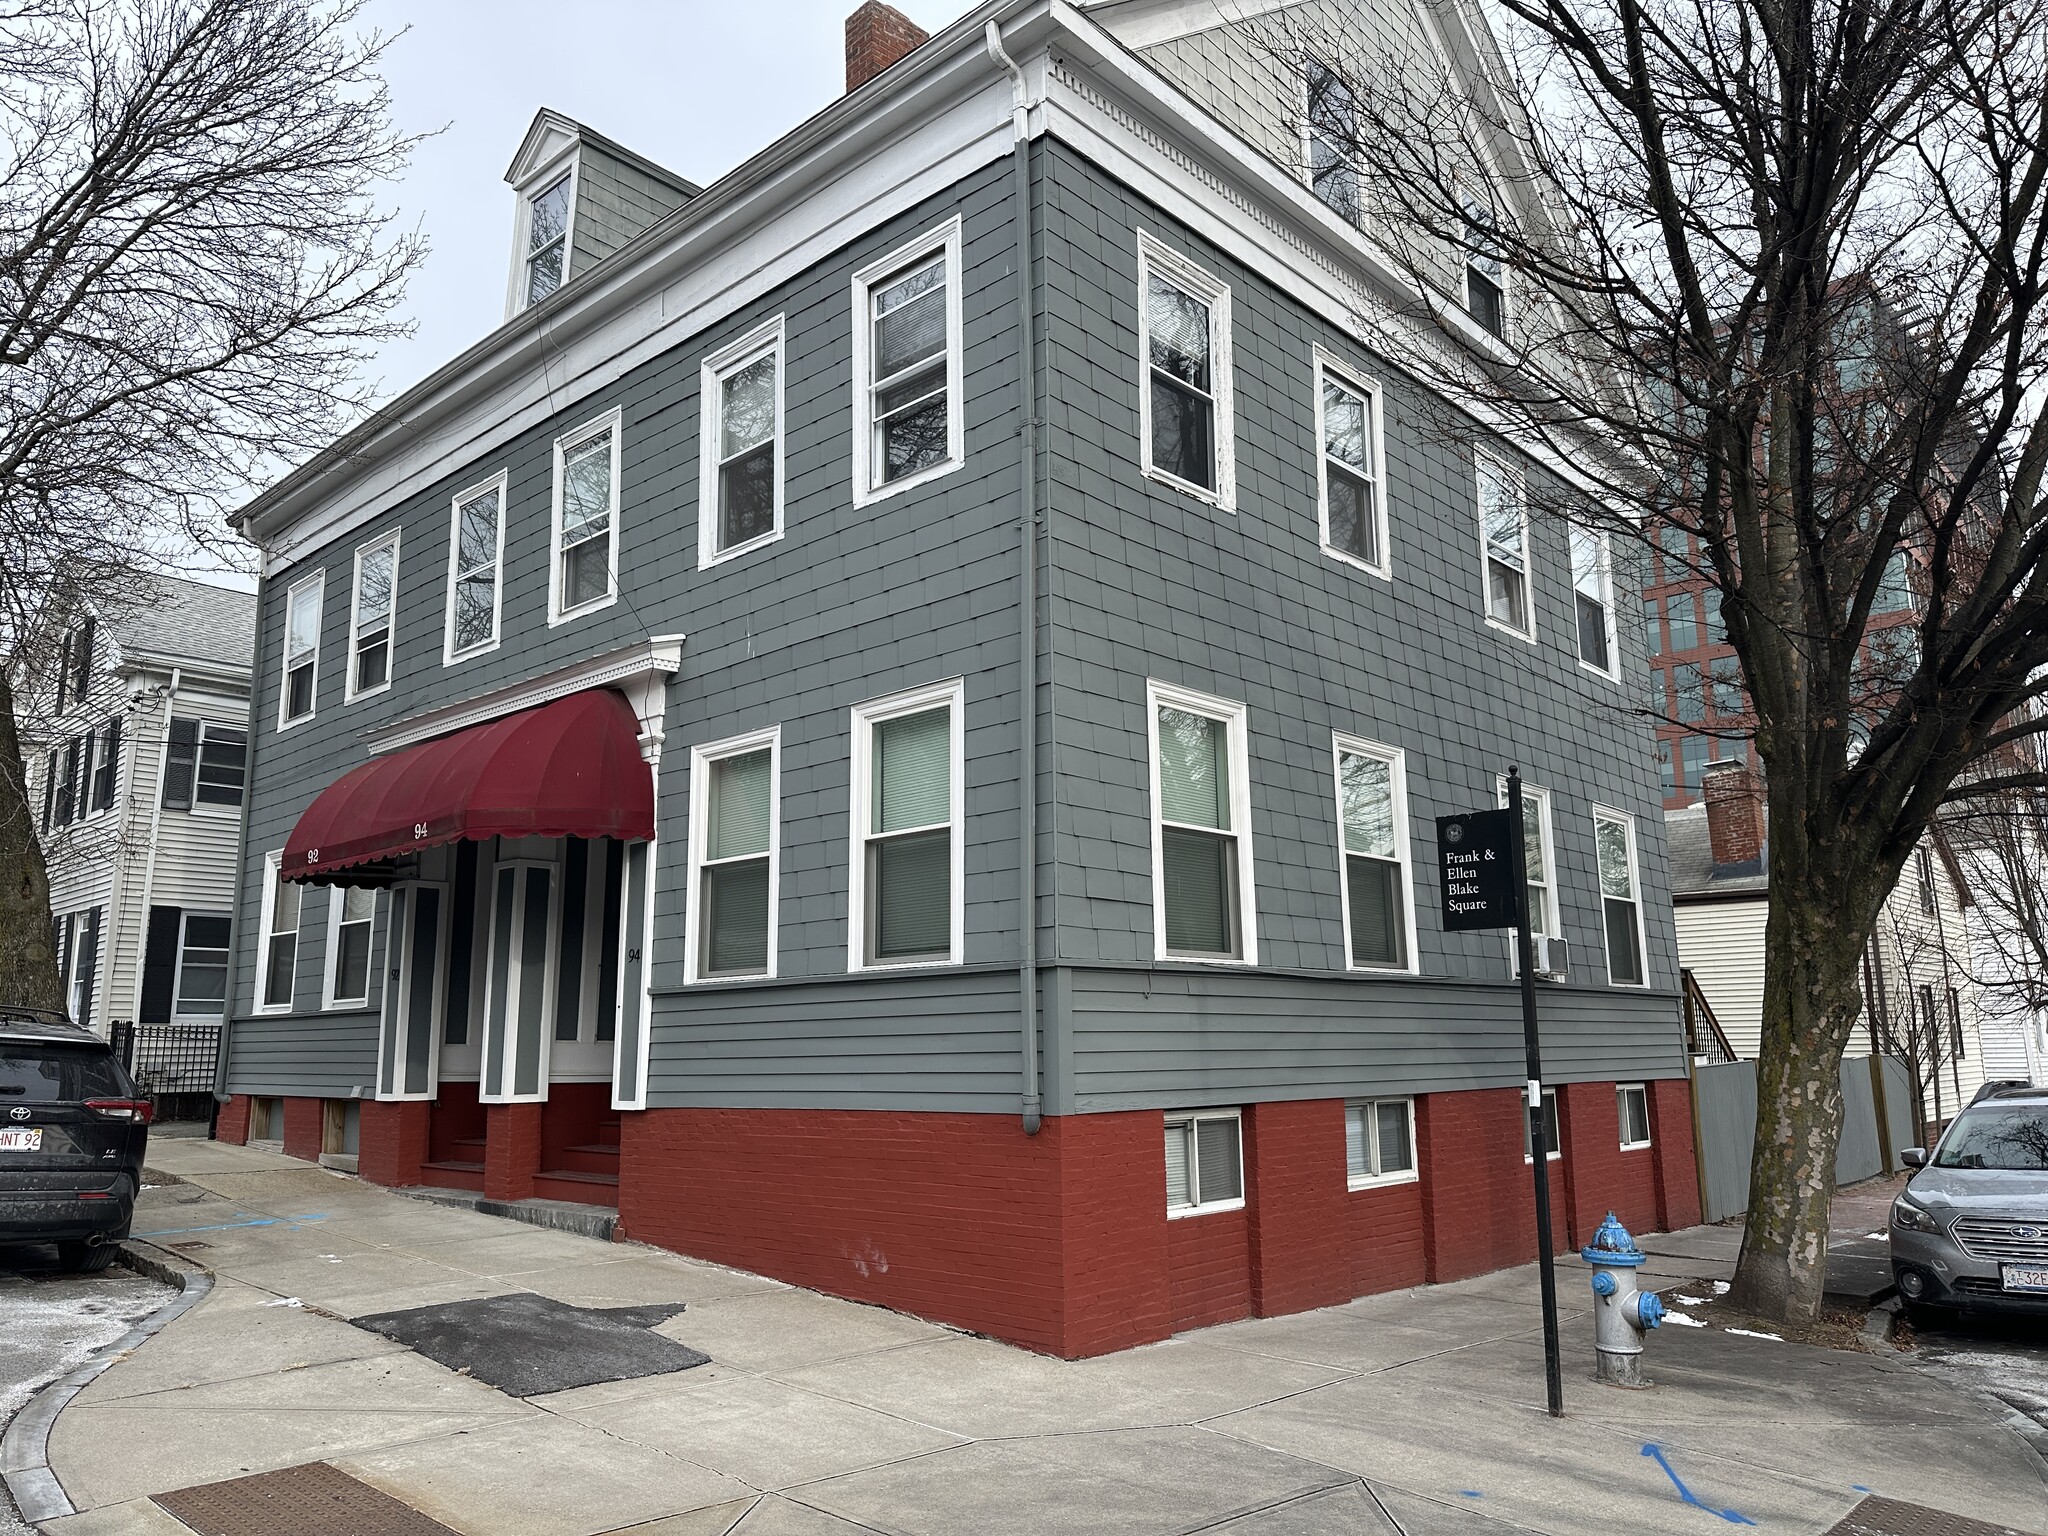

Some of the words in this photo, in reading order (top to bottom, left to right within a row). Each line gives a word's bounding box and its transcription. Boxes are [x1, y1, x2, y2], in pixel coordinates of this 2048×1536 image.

[414, 822, 428, 839] 94
[307, 849, 319, 864] 92
[1446, 850, 1480, 865] Frank
[1484, 849, 1496, 861] &
[1447, 867, 1477, 880] Ellen
[1448, 883, 1480, 896] Blake
[1448, 899, 1488, 914] Square
[628, 948, 641, 963] 94
[391, 968, 400, 981] 92
[24, 1133, 41, 1147] 92
